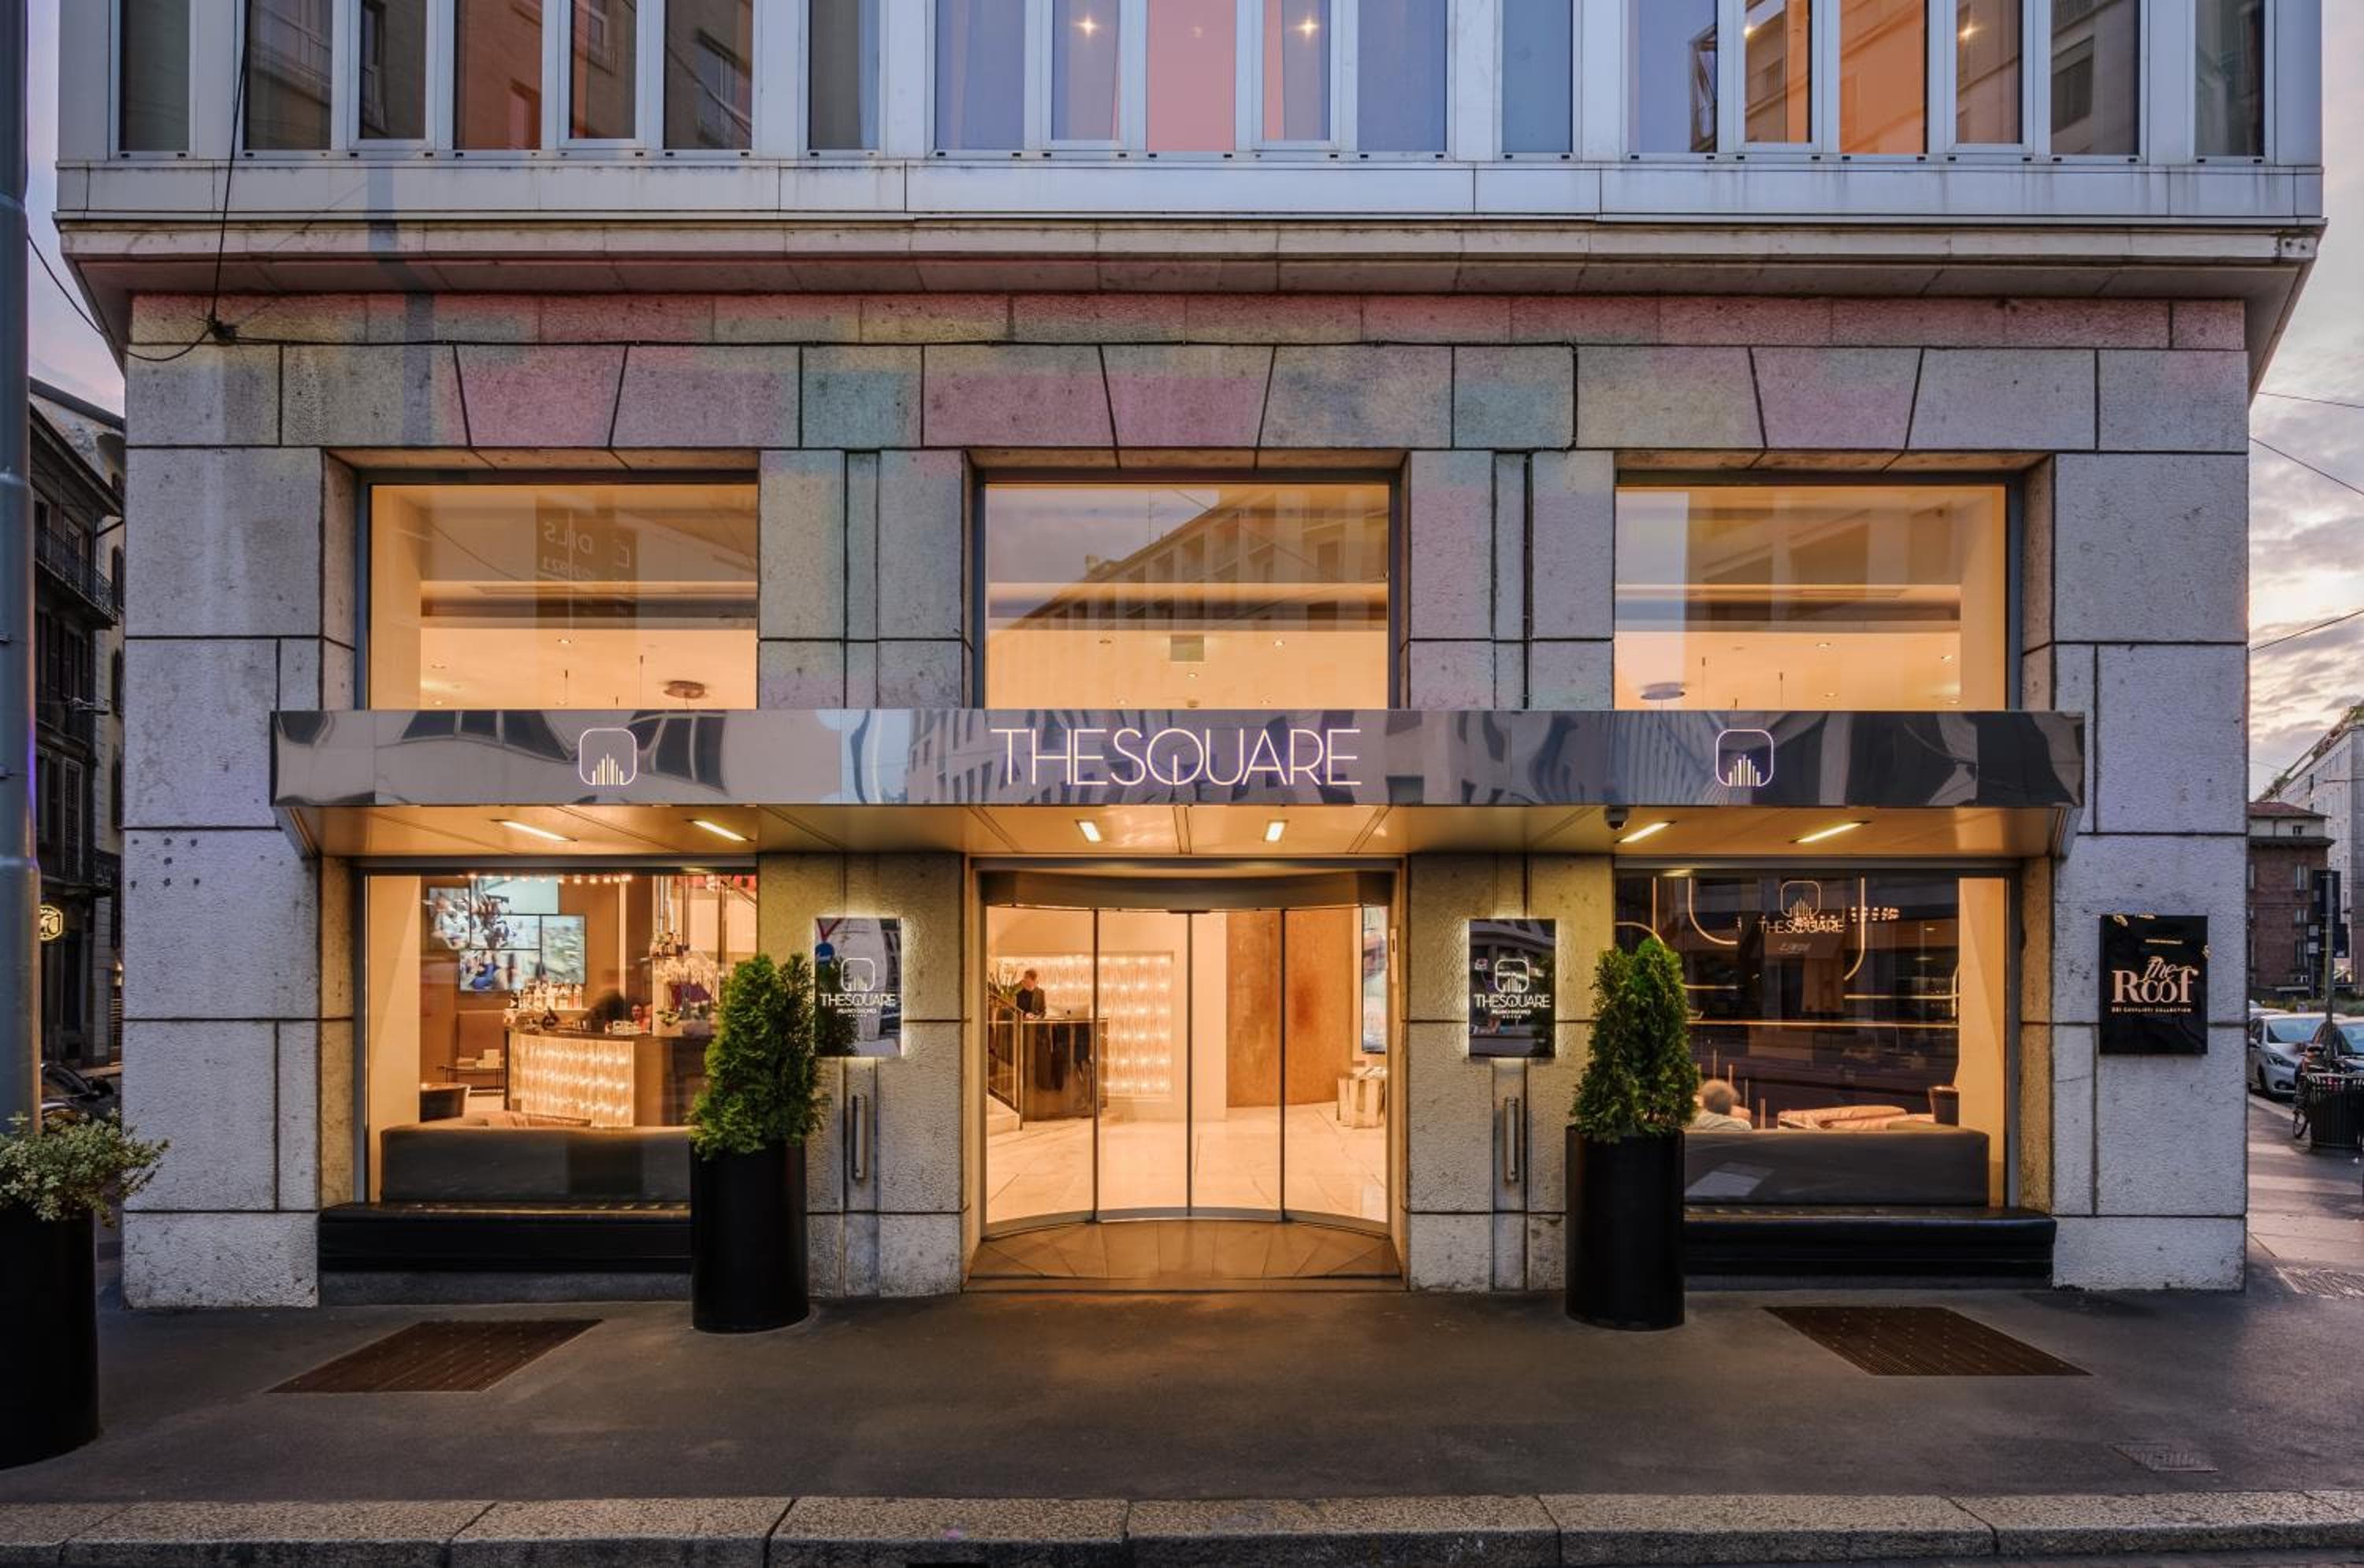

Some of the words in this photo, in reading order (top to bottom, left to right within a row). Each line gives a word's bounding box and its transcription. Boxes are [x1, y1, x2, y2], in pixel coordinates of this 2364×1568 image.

[991, 728, 1362, 785] THESQUARE
[2143, 956, 2180, 979] The
[2112, 967, 2199, 1003] Roof
[820, 994, 896, 1006] THESQUARE
[1474, 994, 1552, 1008] THESQUARE
